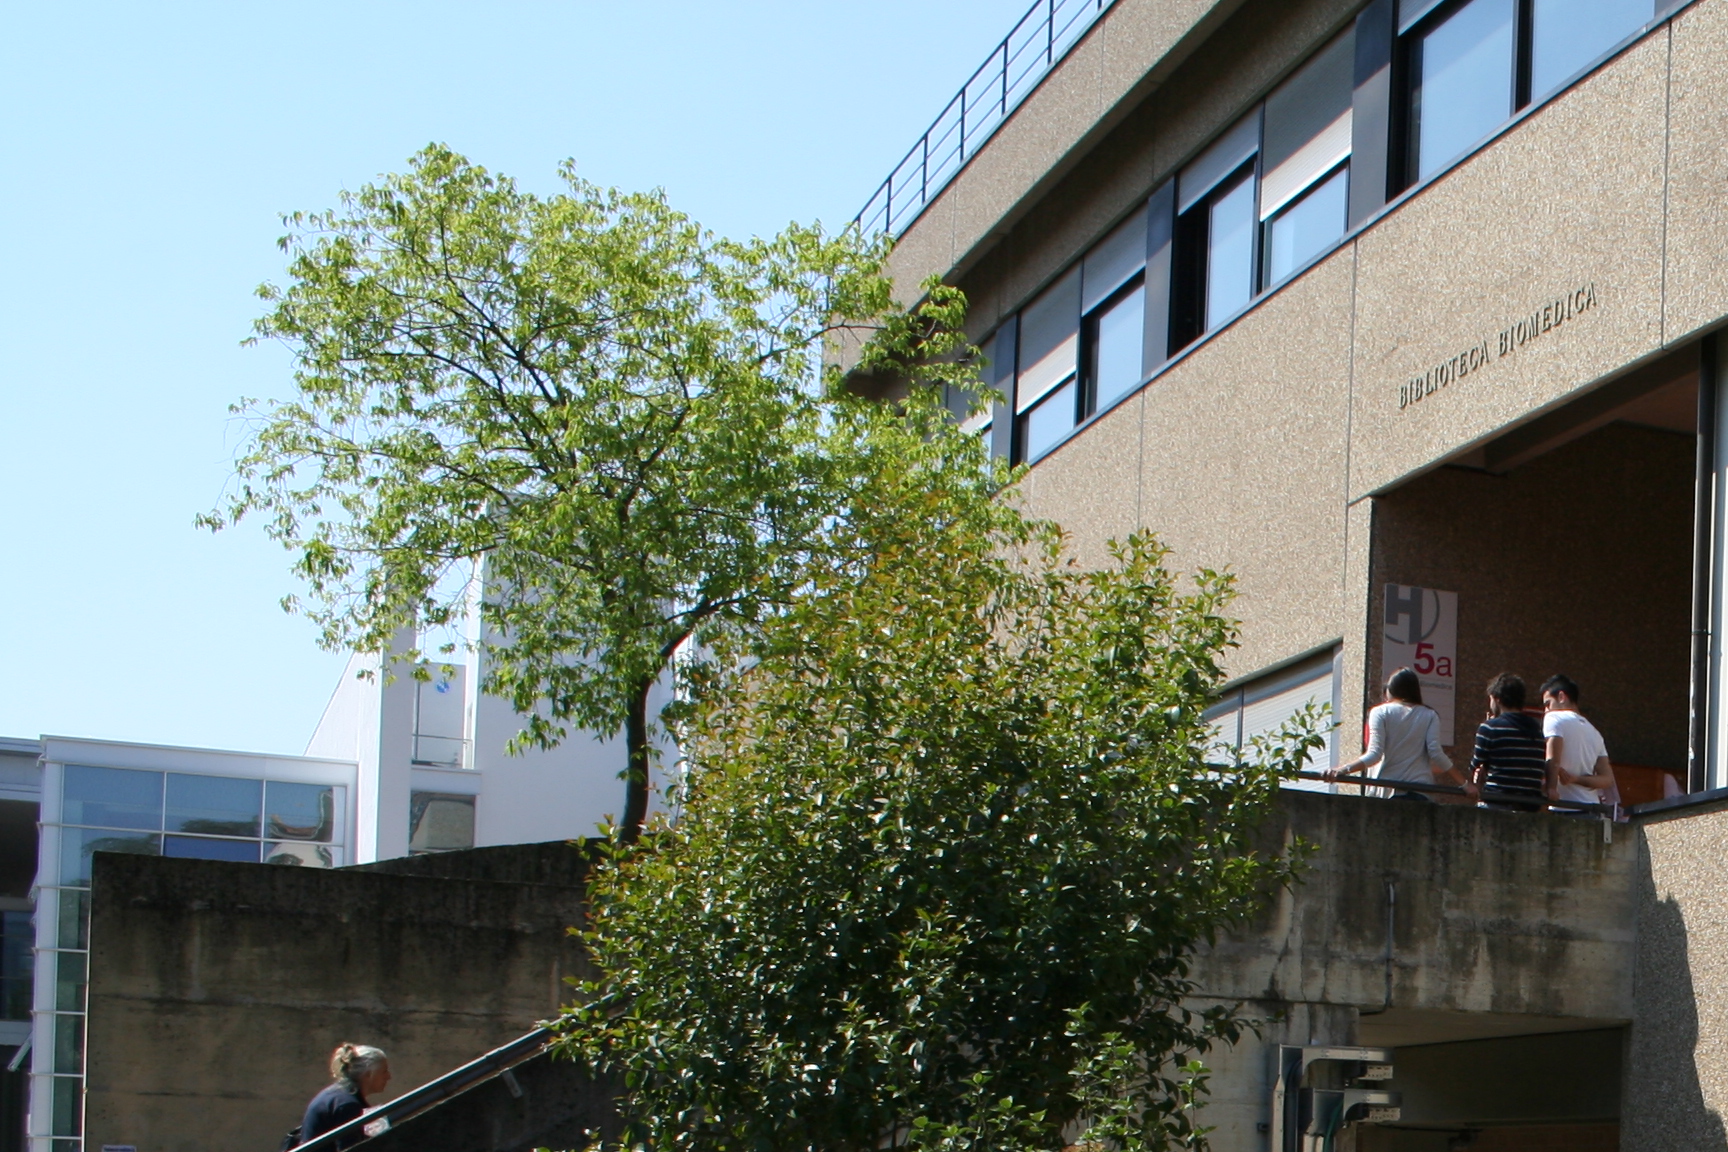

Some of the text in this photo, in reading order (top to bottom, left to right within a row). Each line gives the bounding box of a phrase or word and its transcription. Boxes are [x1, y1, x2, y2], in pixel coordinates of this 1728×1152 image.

[1398, 282, 1597, 409] BIBLIOTECA BIOMEDICA
[1386, 584, 1423, 644] H
[1413, 642, 1452, 677] 5a
